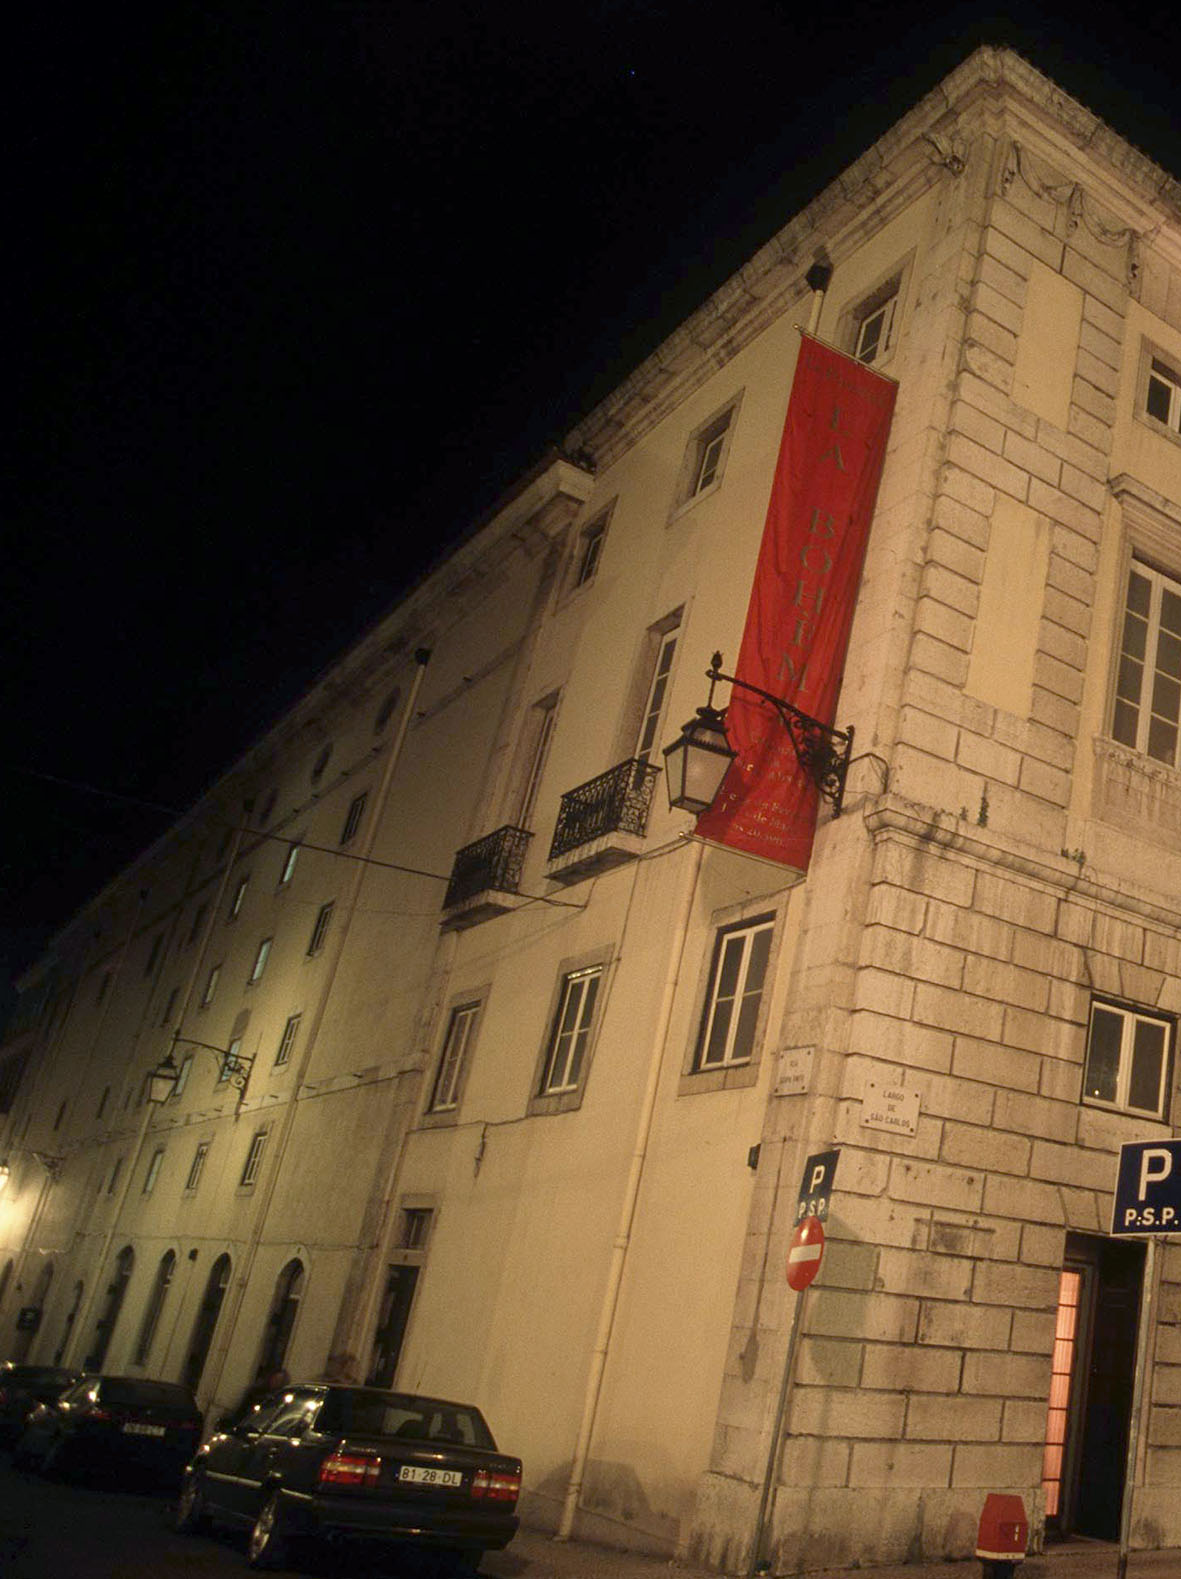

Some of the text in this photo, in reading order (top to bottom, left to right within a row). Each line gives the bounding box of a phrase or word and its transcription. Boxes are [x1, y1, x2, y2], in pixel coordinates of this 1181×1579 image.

[883, 1090, 905, 1102] LARGO
[809, 1164, 826, 1194] P
[1138, 1148, 1173, 1201] P
